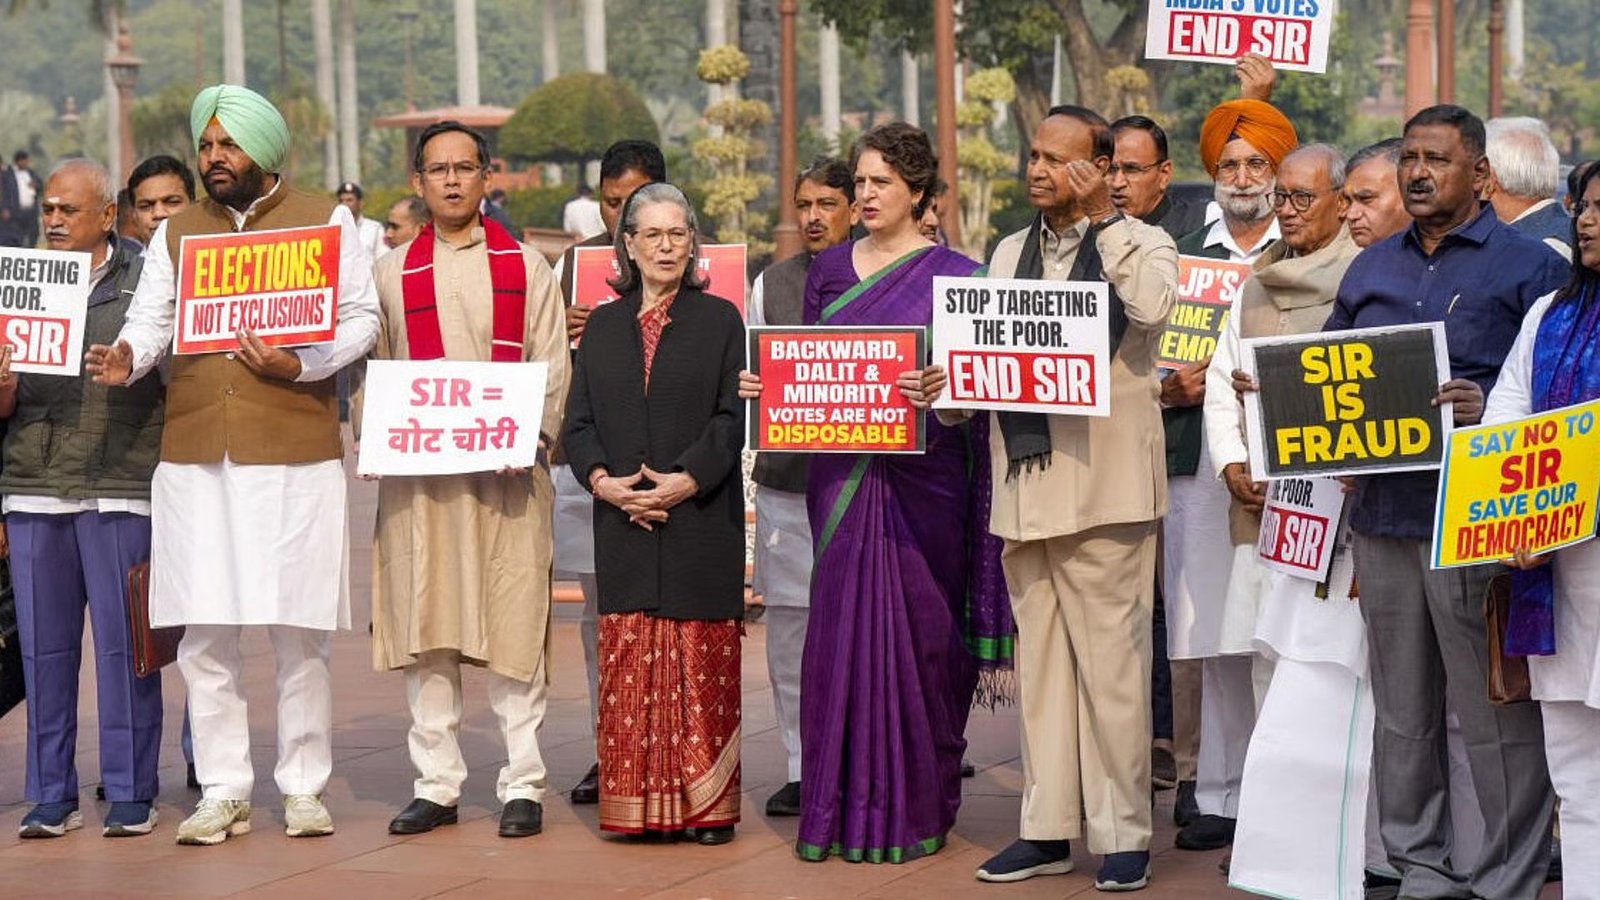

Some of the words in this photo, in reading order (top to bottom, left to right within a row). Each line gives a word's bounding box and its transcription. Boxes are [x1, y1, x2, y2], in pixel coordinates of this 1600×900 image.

[1172, 13, 1240, 56] END
[1251, 18, 1307, 63] SIR
[0, 256, 79, 285] RGETING
[1178, 266, 1240, 302] JP'S
[0, 285, 46, 311] OOR.
[192, 302, 225, 336] NOT
[228, 293, 325, 332] EXCLUSIONS
[945, 287, 991, 315] STOP
[997, 289, 1098, 318] TARGETING
[6, 318, 65, 364] SIR
[770, 340, 904, 362] BACKWARD,
[972, 319, 1006, 345] THE
[1012, 320, 1069, 348] POOR.
[795, 362, 858, 382] DALIT
[863, 363, 880, 382] &
[952, 354, 1022, 400] END
[1032, 356, 1094, 404] SIR
[1300, 342, 1377, 385] SIR
[410, 378, 472, 407] SIR
[783, 384, 893, 404] MINORITY
[1321, 381, 1366, 422] IS
[767, 407, 826, 424] VOTES
[829, 407, 866, 424] ARE
[870, 407, 908, 424] NOT
[767, 424, 908, 445] DISPOSABLE
[1469, 428, 1517, 458] SAY
[1522, 420, 1558, 448] NO
[1564, 410, 1595, 438] TO
[388, 417, 445, 454] वोट
[452, 416, 519, 452] चोरी
[1275, 417, 1432, 466] FRAUD
[1499, 448, 1562, 495] SIR
[1281, 478, 1314, 508] POOR.
[1468, 493, 1528, 522] SAVE
[1534, 481, 1578, 511] OUR
[1281, 515, 1324, 568] SIR
[1455, 501, 1587, 561] DEMOCRACY
